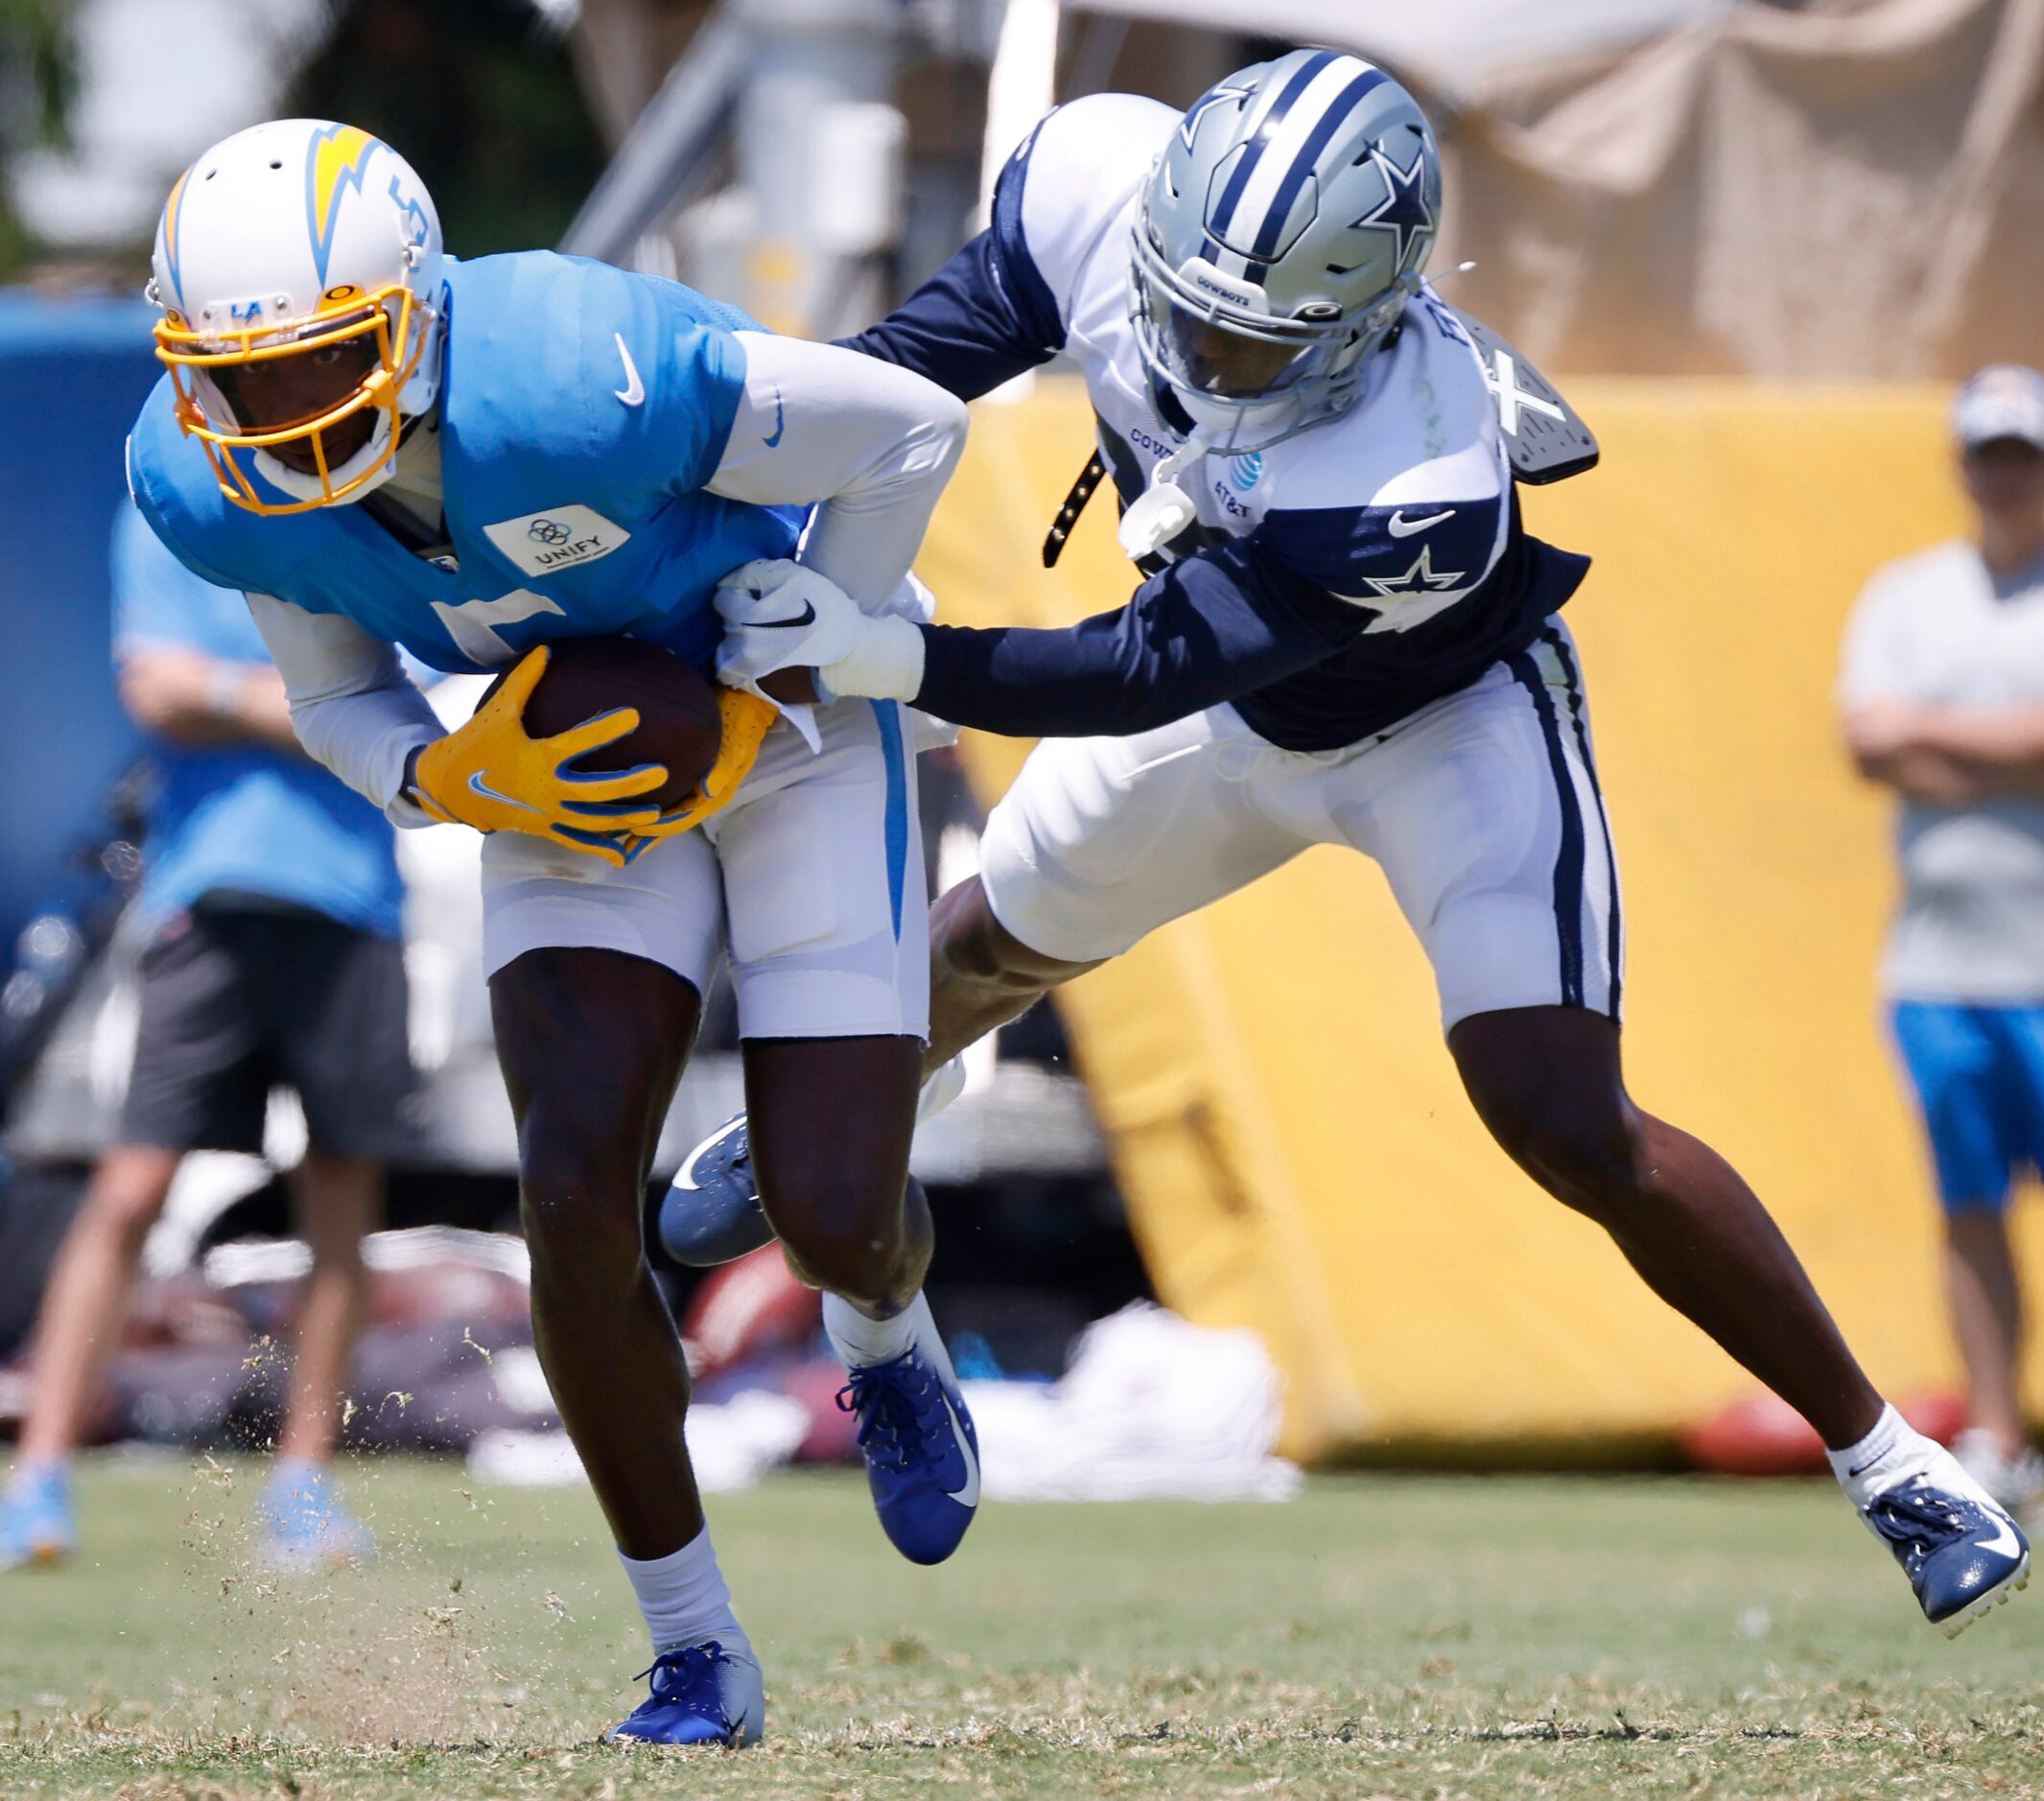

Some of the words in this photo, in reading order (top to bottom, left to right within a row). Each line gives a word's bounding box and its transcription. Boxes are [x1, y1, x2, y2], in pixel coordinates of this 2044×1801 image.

[1197, 275, 1249, 306] COWBOYS
[231, 301, 261, 324] LA
[1131, 428, 1174, 458] COW
[1214, 480, 1251, 518] AT&T
[535, 535, 601, 564] UNIFY
